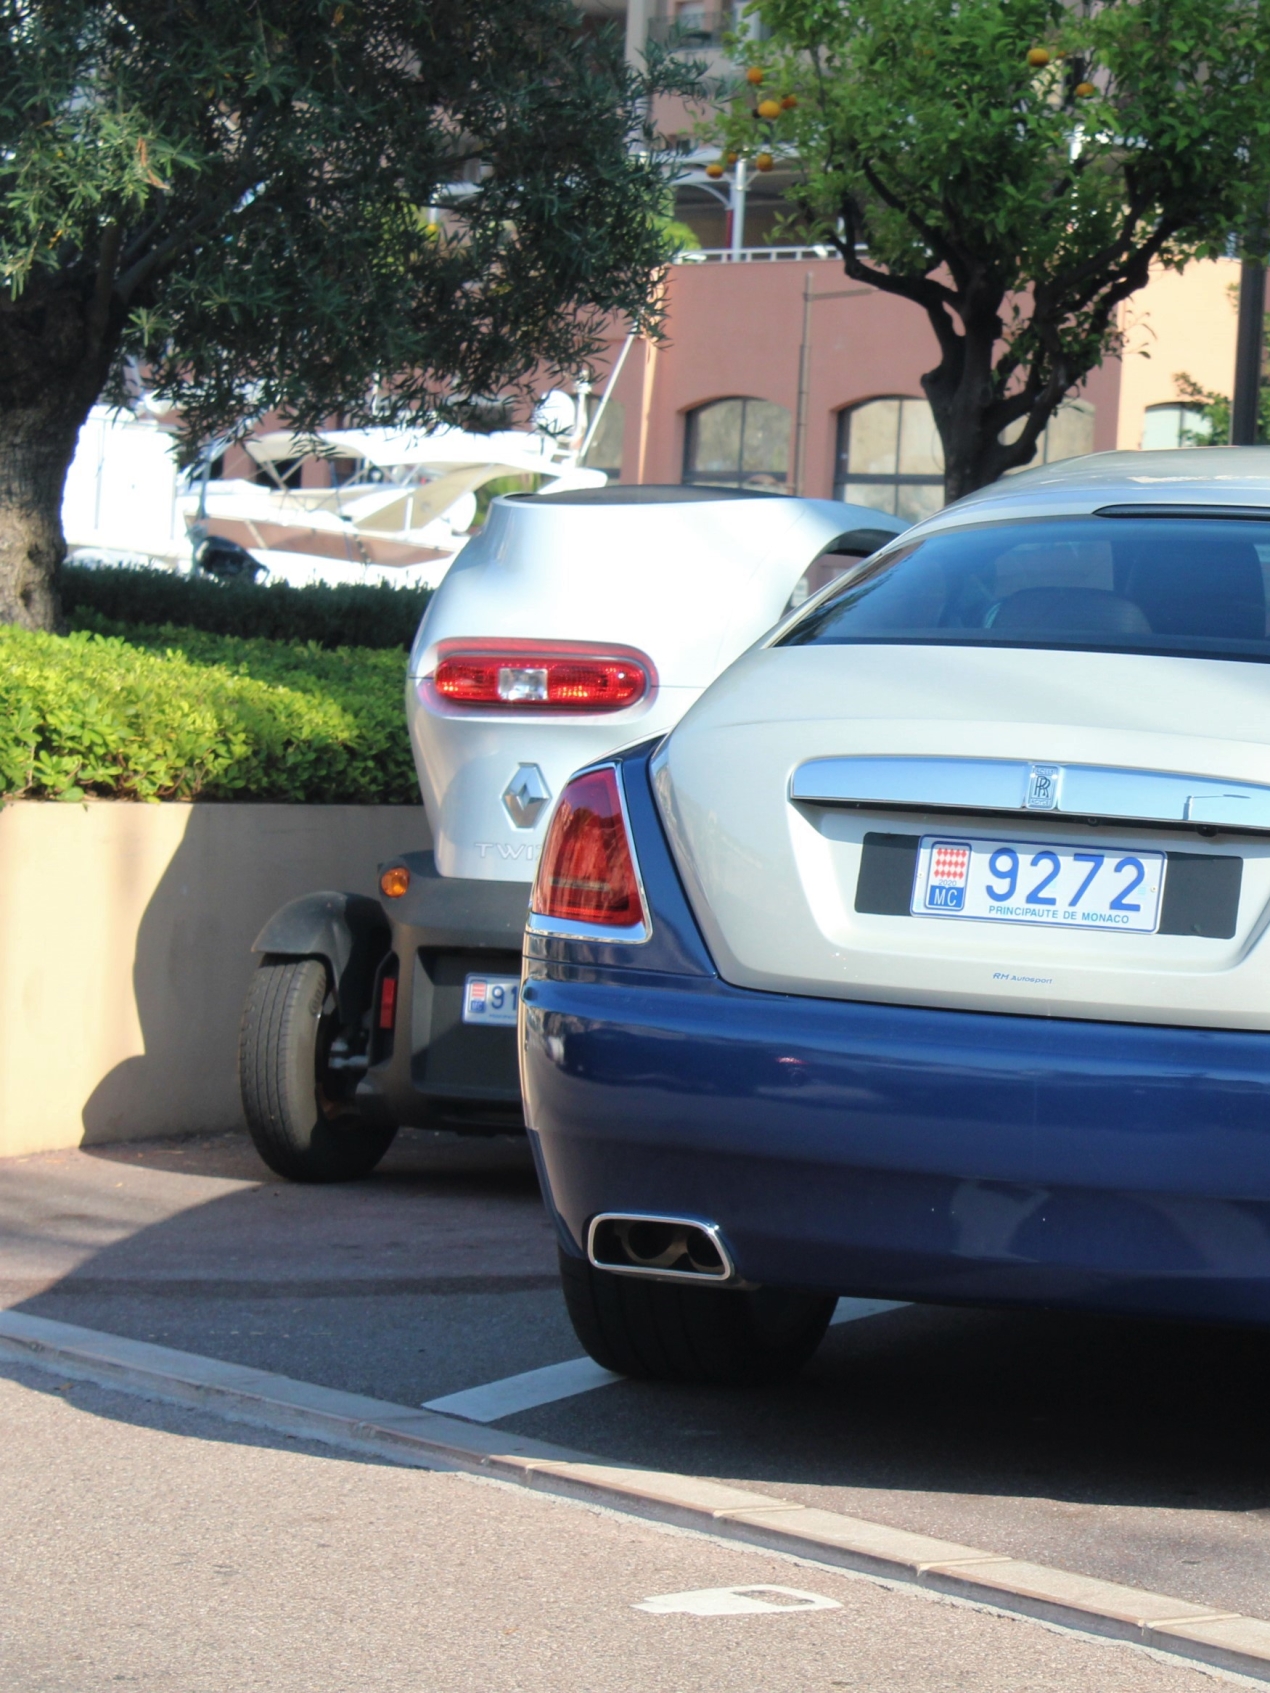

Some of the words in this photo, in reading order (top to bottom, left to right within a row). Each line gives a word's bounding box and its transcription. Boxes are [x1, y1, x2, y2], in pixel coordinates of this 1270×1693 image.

[985, 847, 1146, 912] 9272
[933, 888, 958, 906] MC
[988, 905, 1059, 919] PRINCIPAUTE
[1063, 911, 1078, 920] DE
[1081, 912, 1130, 924] MONACO
